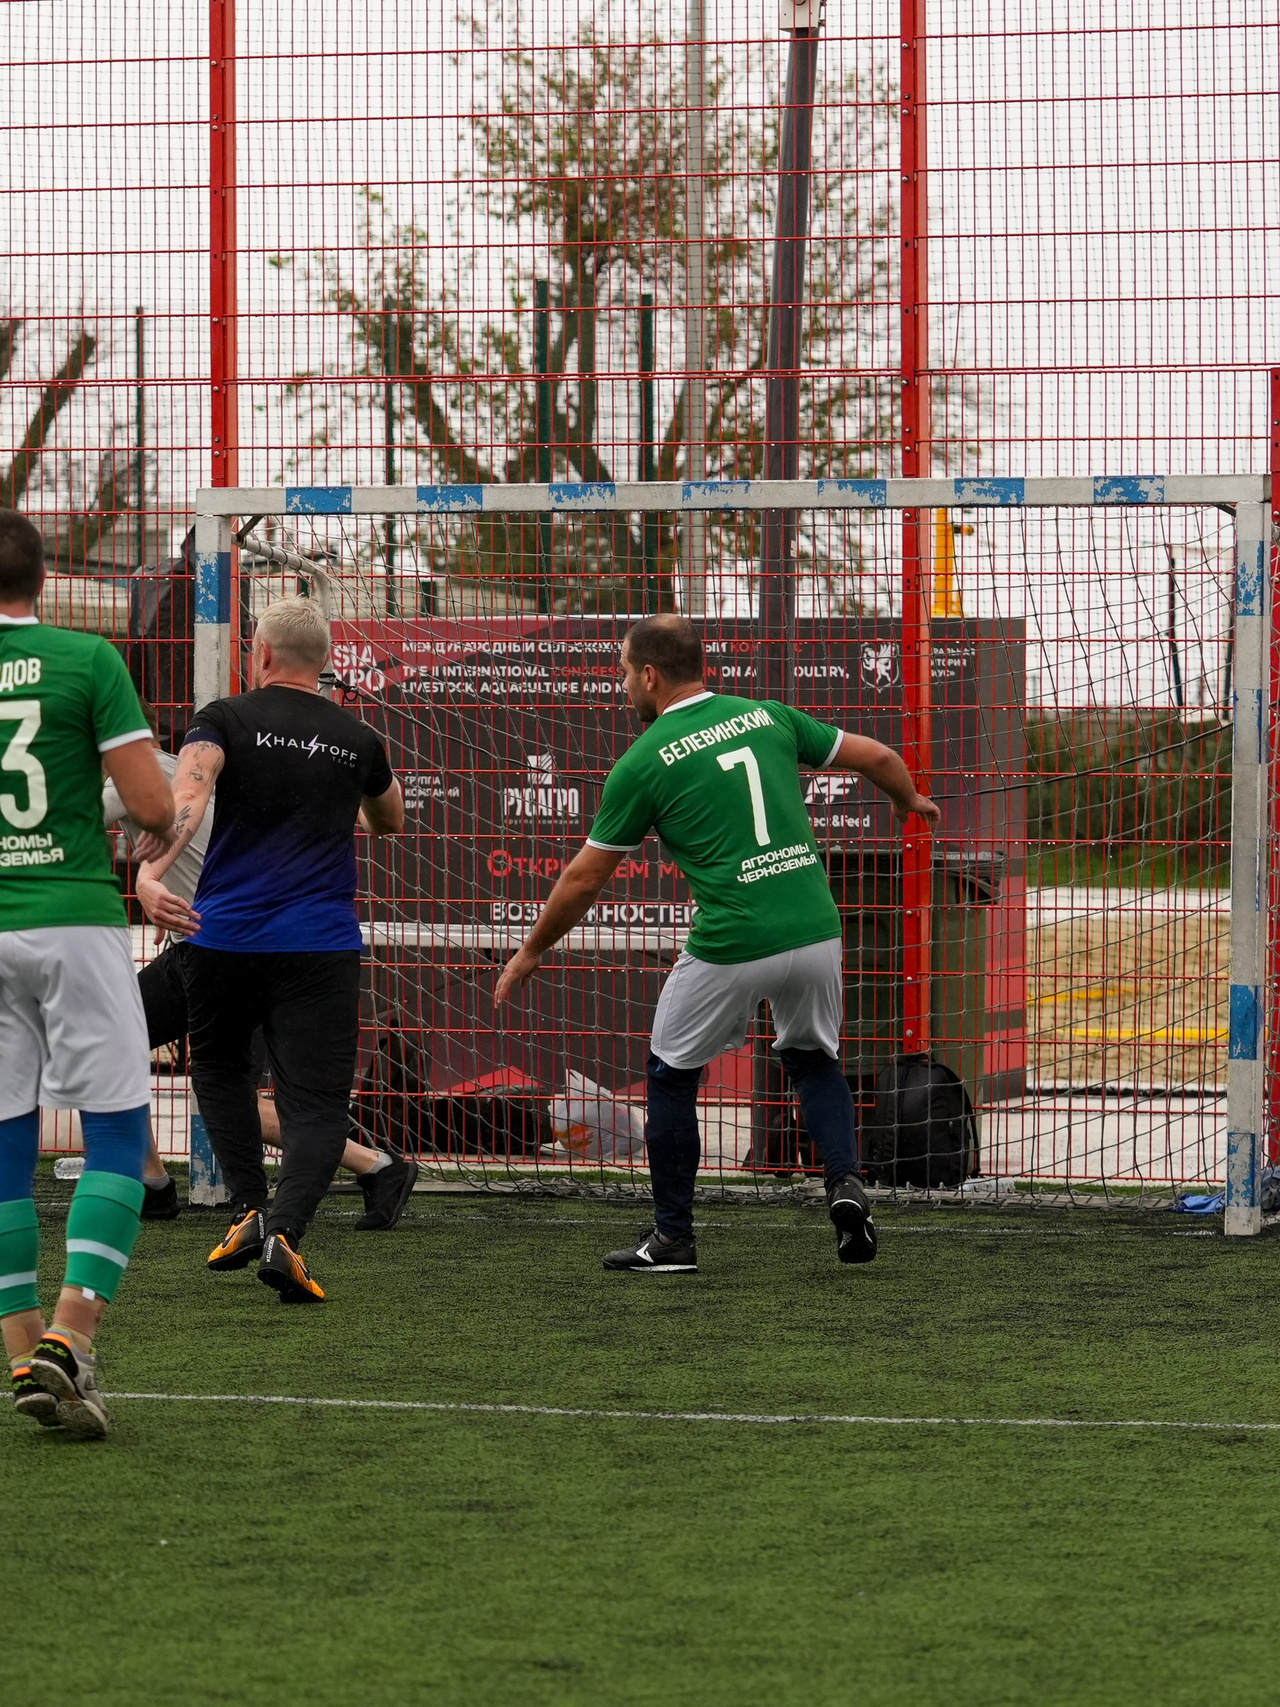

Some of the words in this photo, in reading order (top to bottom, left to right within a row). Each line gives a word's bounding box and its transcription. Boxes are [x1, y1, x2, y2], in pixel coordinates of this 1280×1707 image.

[333, 644, 377, 668] SIA
[402, 666, 427, 677] THE
[443, 666, 549, 677] INTERNATIONAL
[794, 666, 849, 679] OULTRY,
[480, 682, 578, 695] AQUACULTURE
[583, 682, 611, 694] AND
[658, 708, 774, 766] БЕЛЕВИНСКИЙ
[331, 756, 356, 769] TEAM
[504, 788, 579, 816] РУСАГРО
[716, 746, 771, 846] 7
[808, 815, 870, 827] tect&Feed
[737, 854, 817, 883] ЧЕРНОЗЕМЬЯ
[741, 843, 809, 871] АГРОНОМЫ
